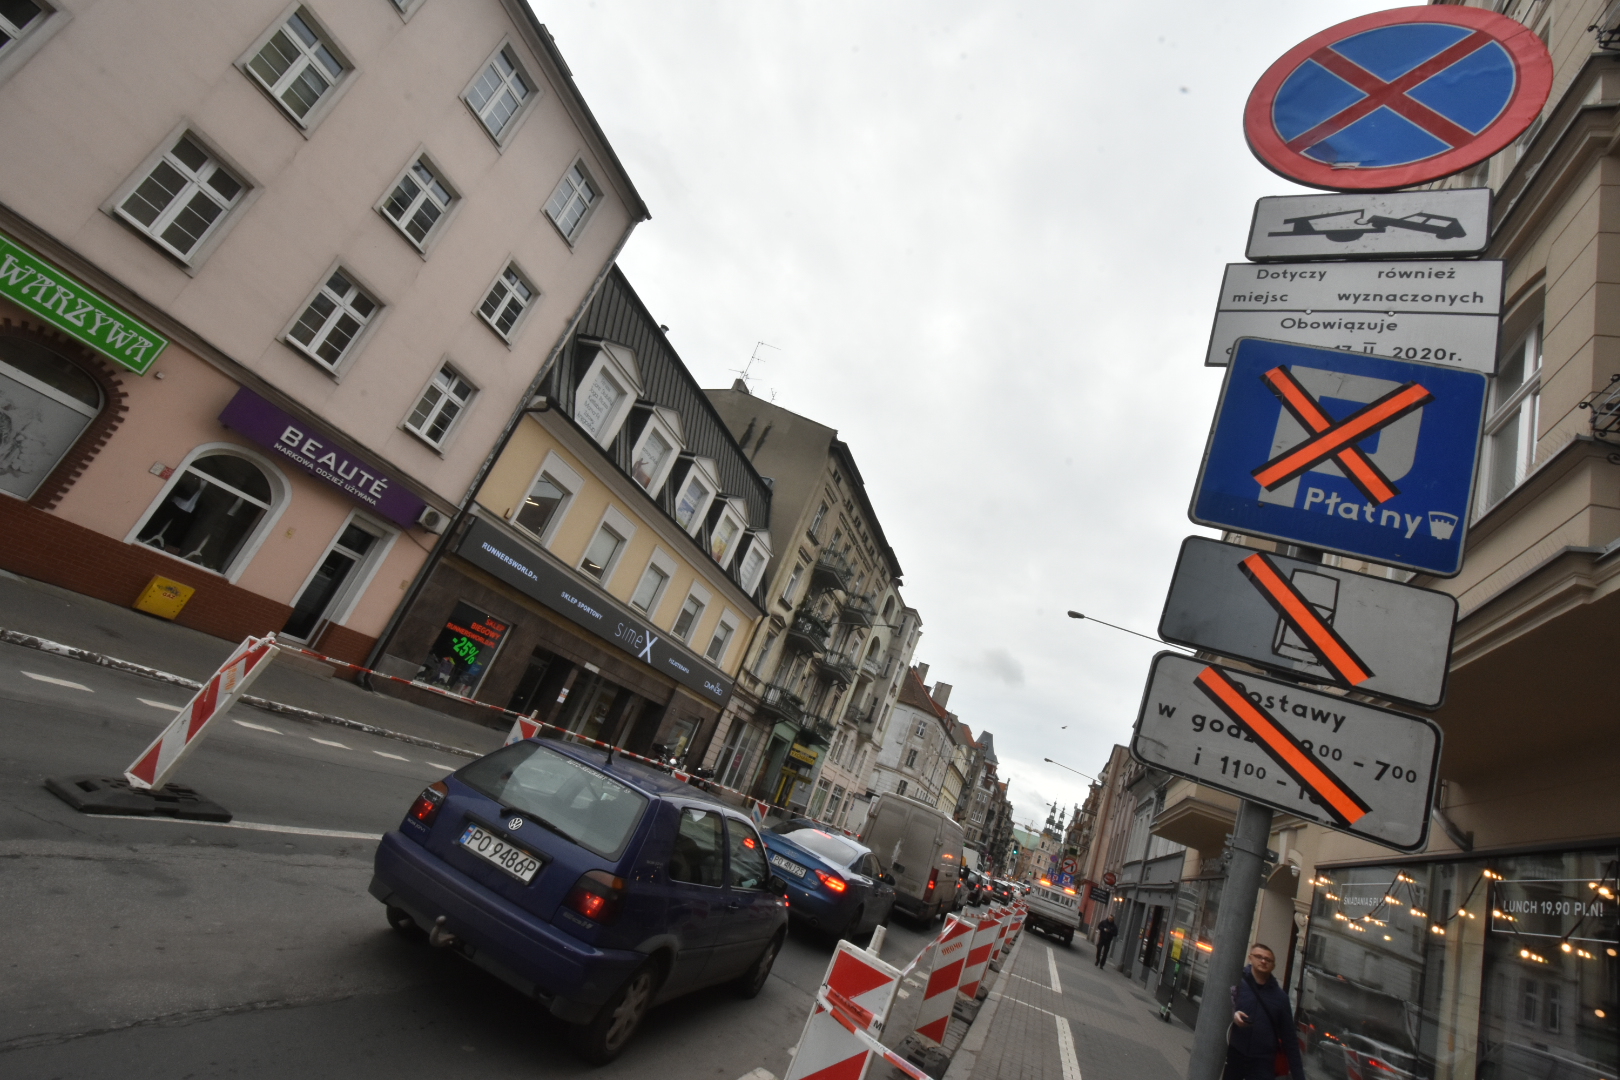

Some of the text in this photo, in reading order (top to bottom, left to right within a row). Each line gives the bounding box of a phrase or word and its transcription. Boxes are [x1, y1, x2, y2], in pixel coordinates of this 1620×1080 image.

[1256, 267, 1456, 282] Dotyczy również
[0, 253, 153, 363] WARZYWA
[1232, 291, 1484, 307] miejsc wyznaczonych
[1280, 317, 1398, 334] Obowiązuje
[1392, 346, 1462, 362] 2020r.
[280, 425, 388, 499] BEAUTÉ
[273, 442, 377, 507] MARKOWA ODZIEŻ UŻYWANA
[1304, 486, 1423, 539] Płatny
[481, 541, 539, 582] RUNNERSWORLD.PL
[162, 591, 177, 600] GAZ
[561, 591, 604, 620] SKLEP SPORTOWY
[470, 621, 502, 640] BIEGOWY
[452, 636, 480, 665] -25%
[1158, 702, 1177, 719] w
[1194, 746, 1202, 766] i
[466, 829, 537, 877] PO 9486P
[774, 855, 784, 866] PO
[1503, 900, 1538, 914] LUNCH
[1540, 901, 1570, 916] 19,90
